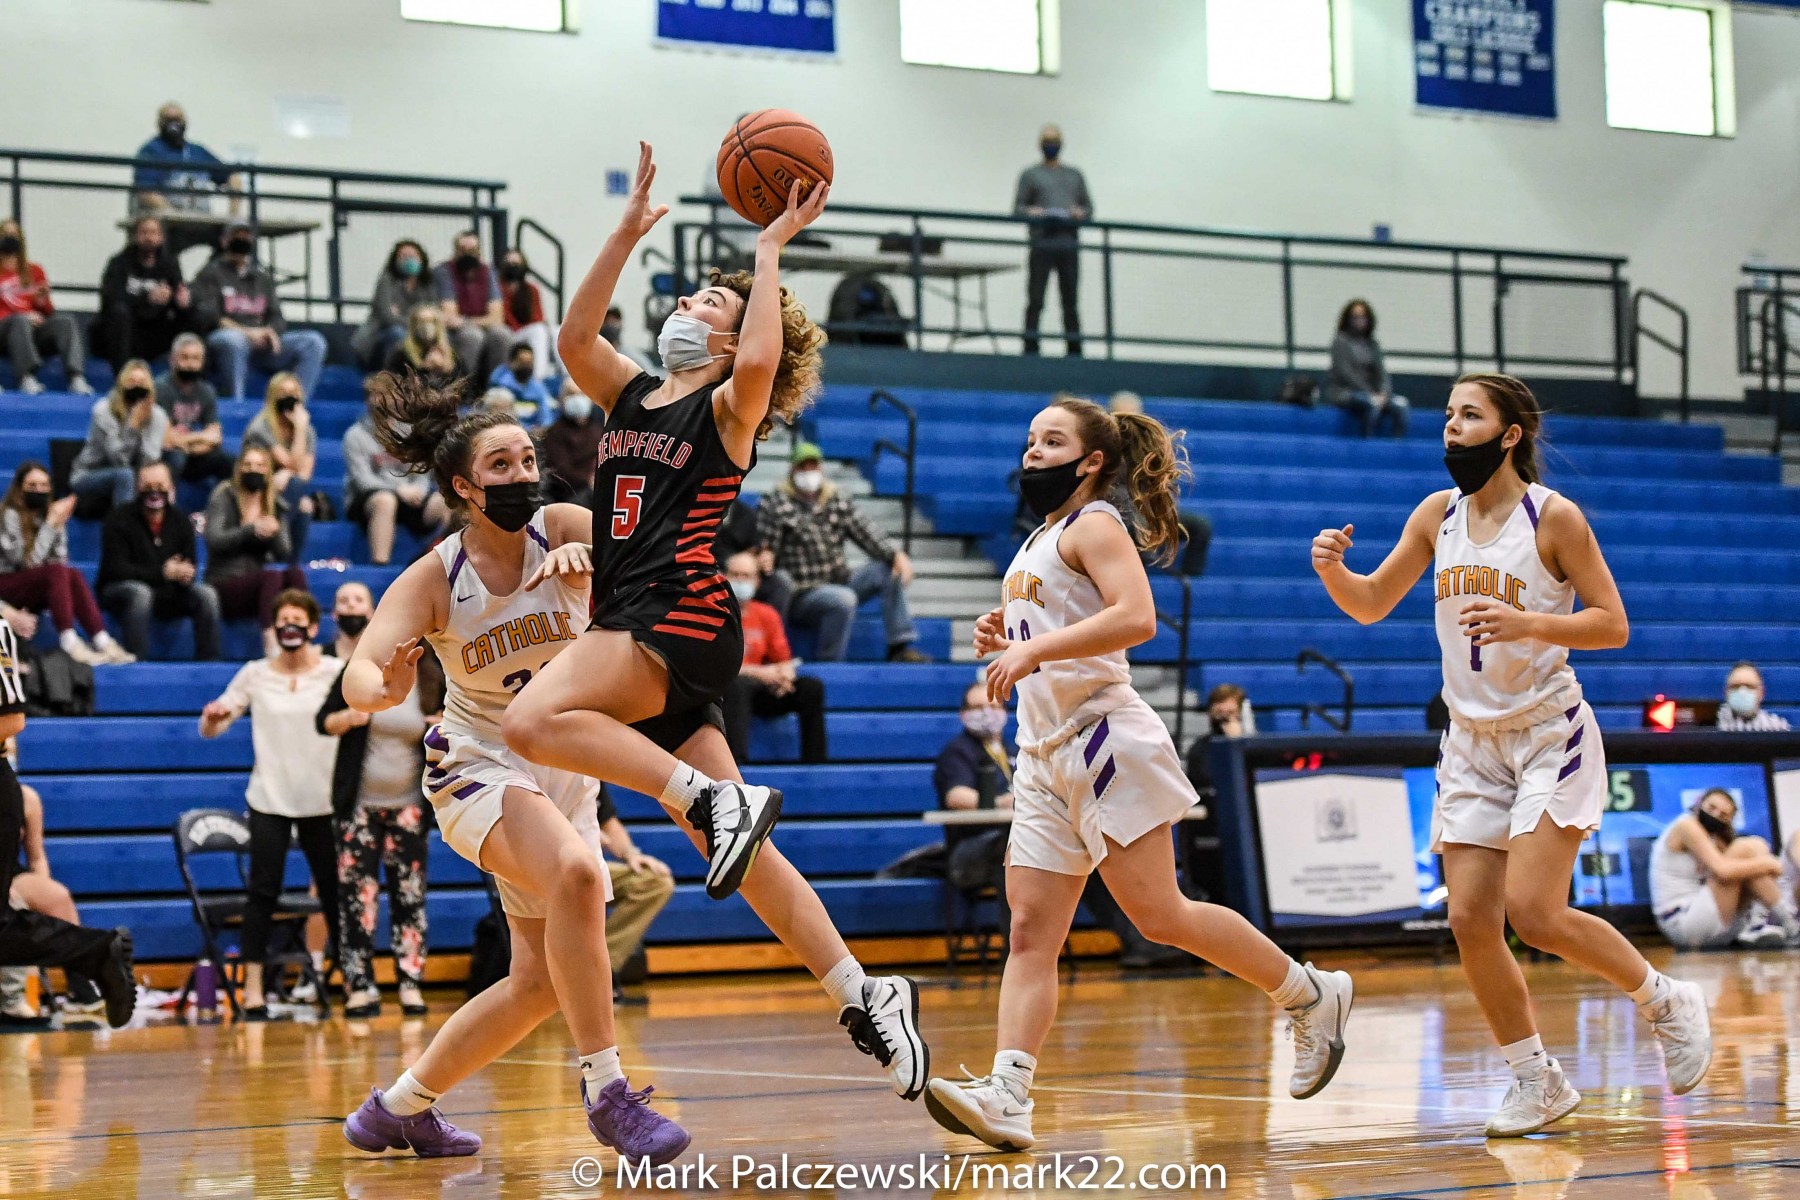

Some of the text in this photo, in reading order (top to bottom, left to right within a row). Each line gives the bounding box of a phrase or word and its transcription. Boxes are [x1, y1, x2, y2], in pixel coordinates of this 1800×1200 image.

[611, 474, 646, 540] 5
[461, 611, 577, 675] CATHOLIC
[1604, 770, 1636, 811] 5
